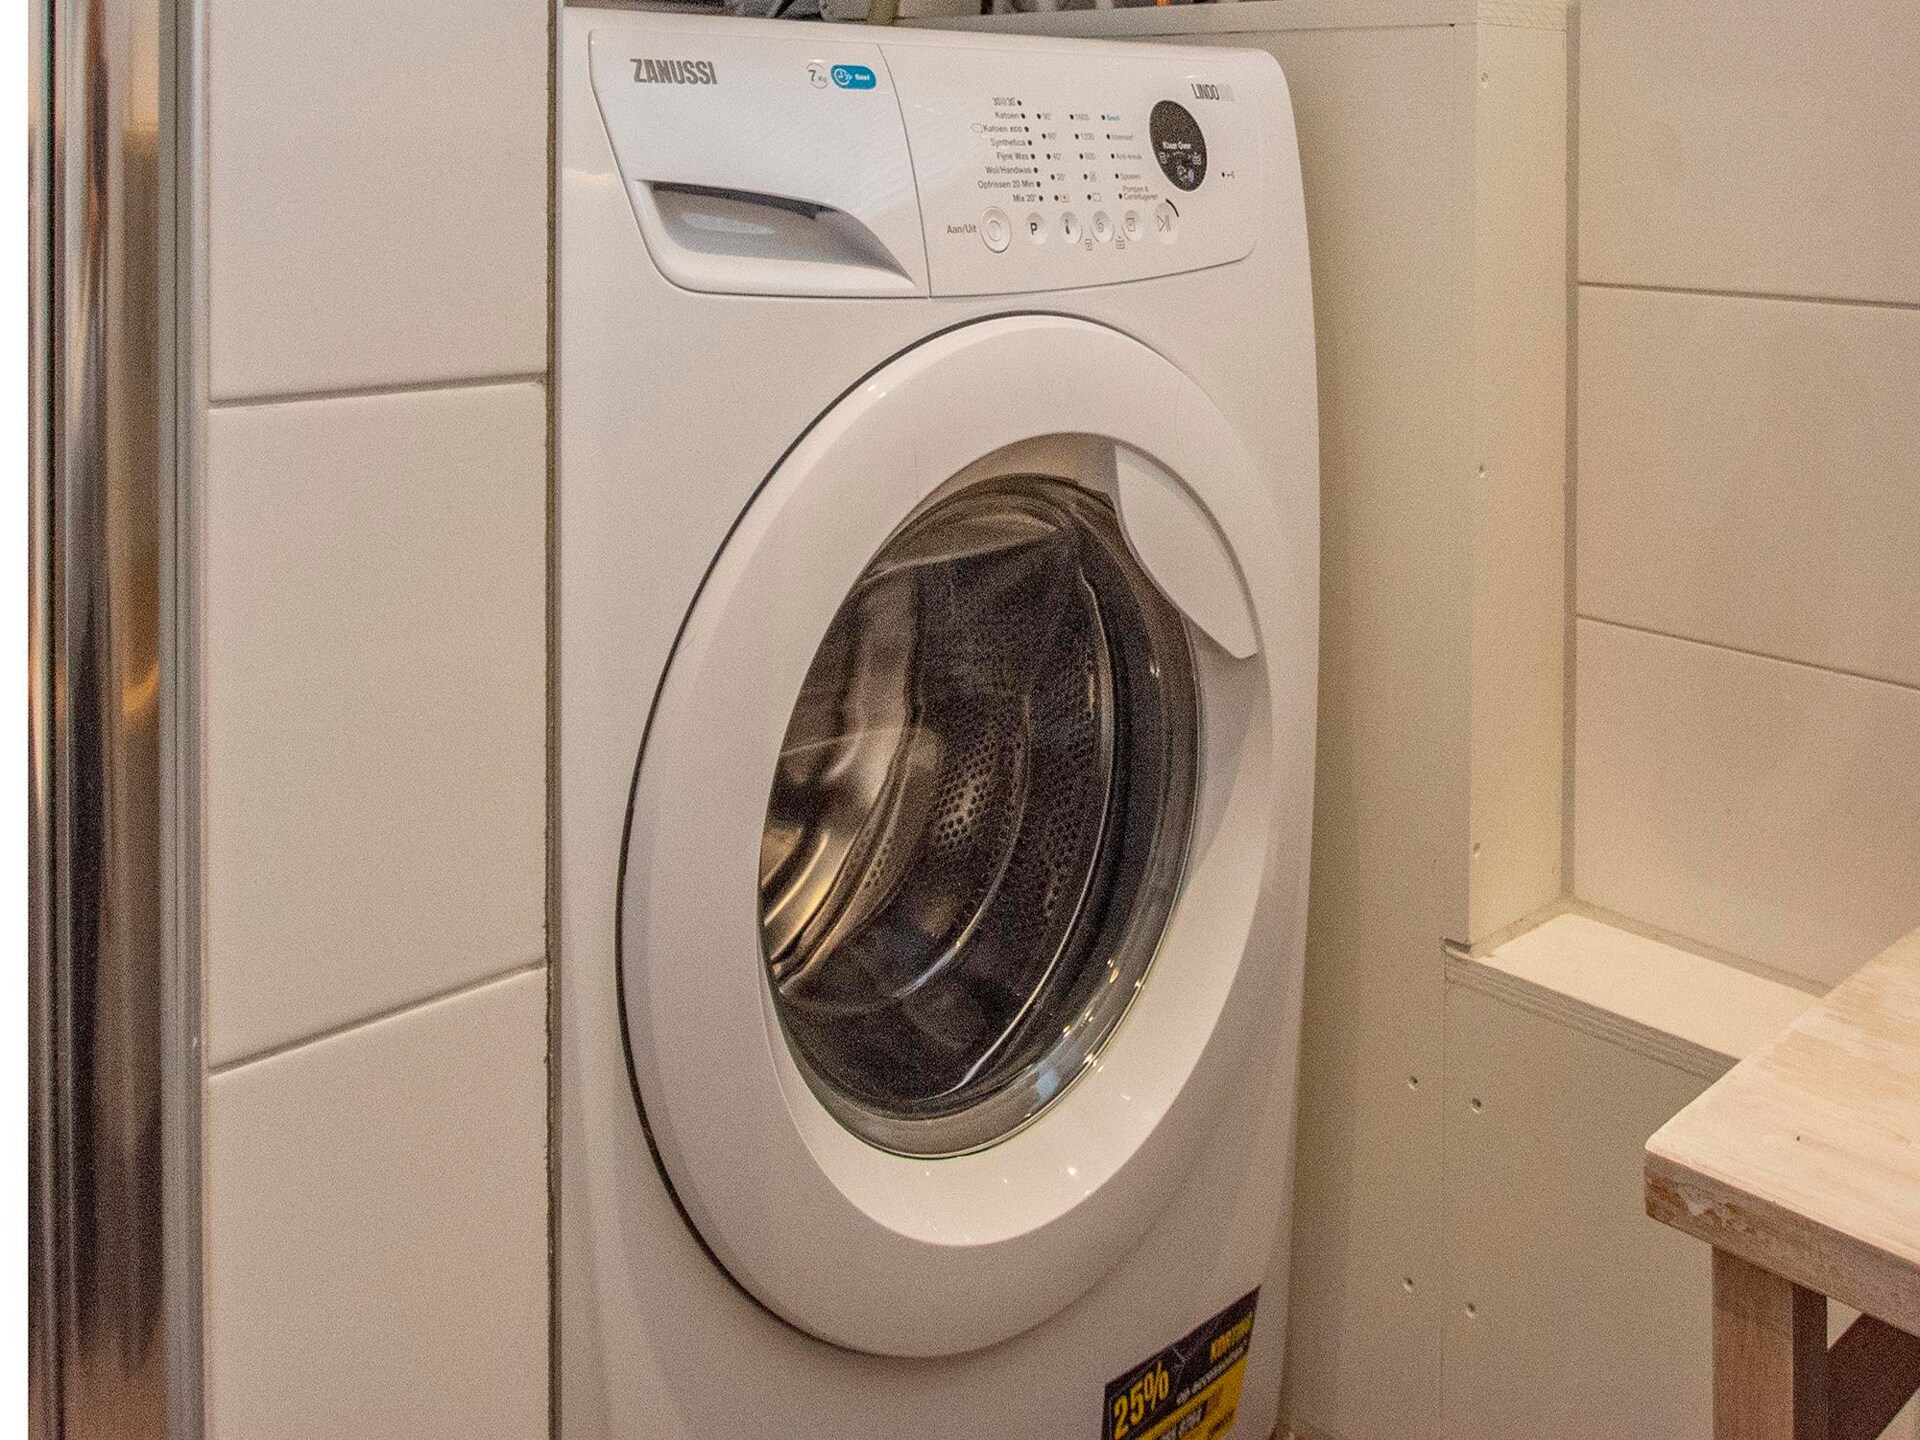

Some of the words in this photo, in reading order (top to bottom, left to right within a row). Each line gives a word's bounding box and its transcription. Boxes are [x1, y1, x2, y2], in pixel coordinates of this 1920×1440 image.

[629, 58, 718, 85] ZANUSSI
[808, 69, 819, 82] 7
[995, 111, 1019, 119] Katoen
[983, 123, 1007, 133] Katoen
[990, 138, 1026, 147] Synthetica
[1014, 152, 1029, 160] Was
[977, 180, 1011, 190] Opfrissen
[1012, 180, 1020, 189] 20
[1021, 180, 1035, 188] Min
[1012, 194, 1025, 202] Mix
[946, 224, 977, 234] Aan/Uit
[1030, 222, 1038, 235] P
[1113, 1361, 1170, 1440] 25%
